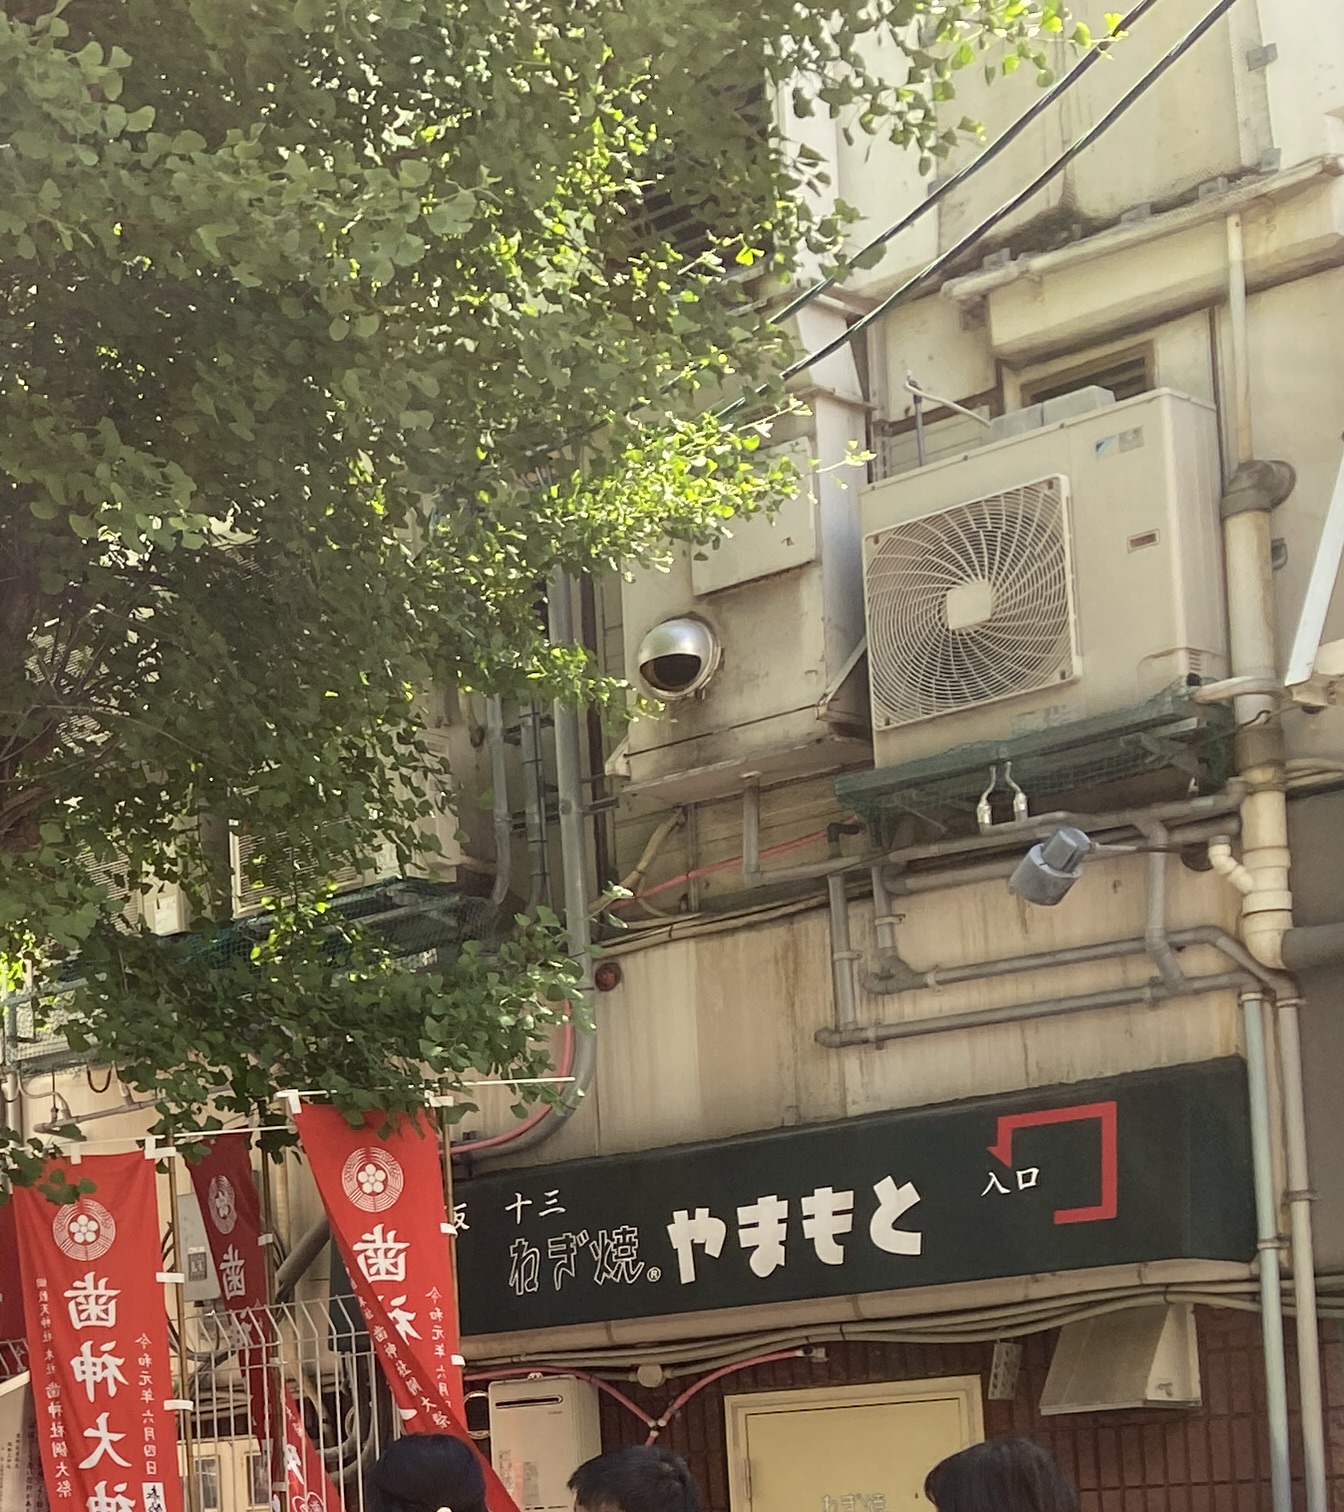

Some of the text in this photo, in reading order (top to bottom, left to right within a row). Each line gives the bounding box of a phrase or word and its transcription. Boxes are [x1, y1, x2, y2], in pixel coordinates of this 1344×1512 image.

[980, 1165, 1041, 1199] 入口
[504, 1189, 566, 1227] 十三
[667, 1175, 924, 1285] やまもと
